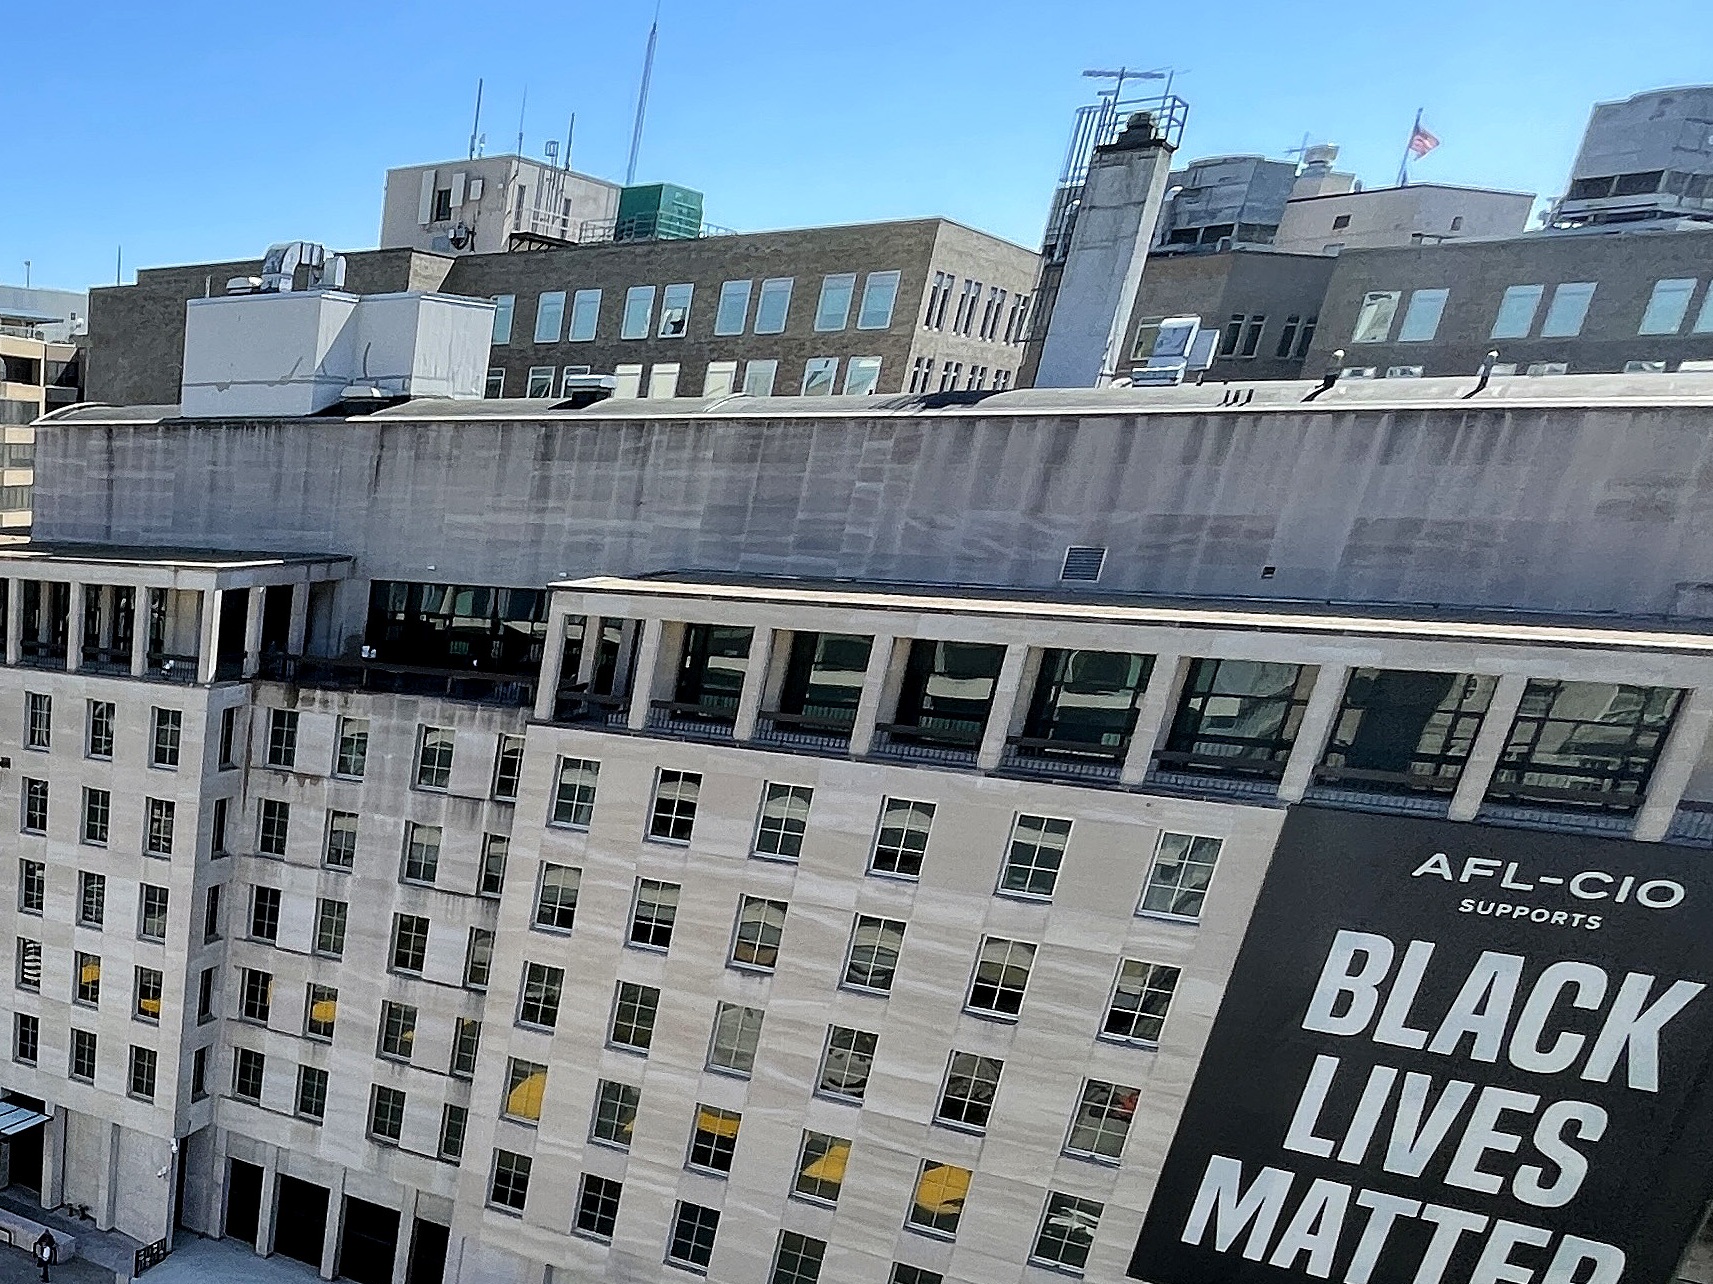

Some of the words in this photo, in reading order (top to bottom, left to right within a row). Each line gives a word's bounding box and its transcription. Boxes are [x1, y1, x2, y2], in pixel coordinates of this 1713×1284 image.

[1411, 853, 1686, 909] AFL-CIO
[1458, 898, 1604, 931] SUPPORTS
[1301, 929, 1707, 1093] BLACK
[1283, 1054, 1608, 1208] LIVES
